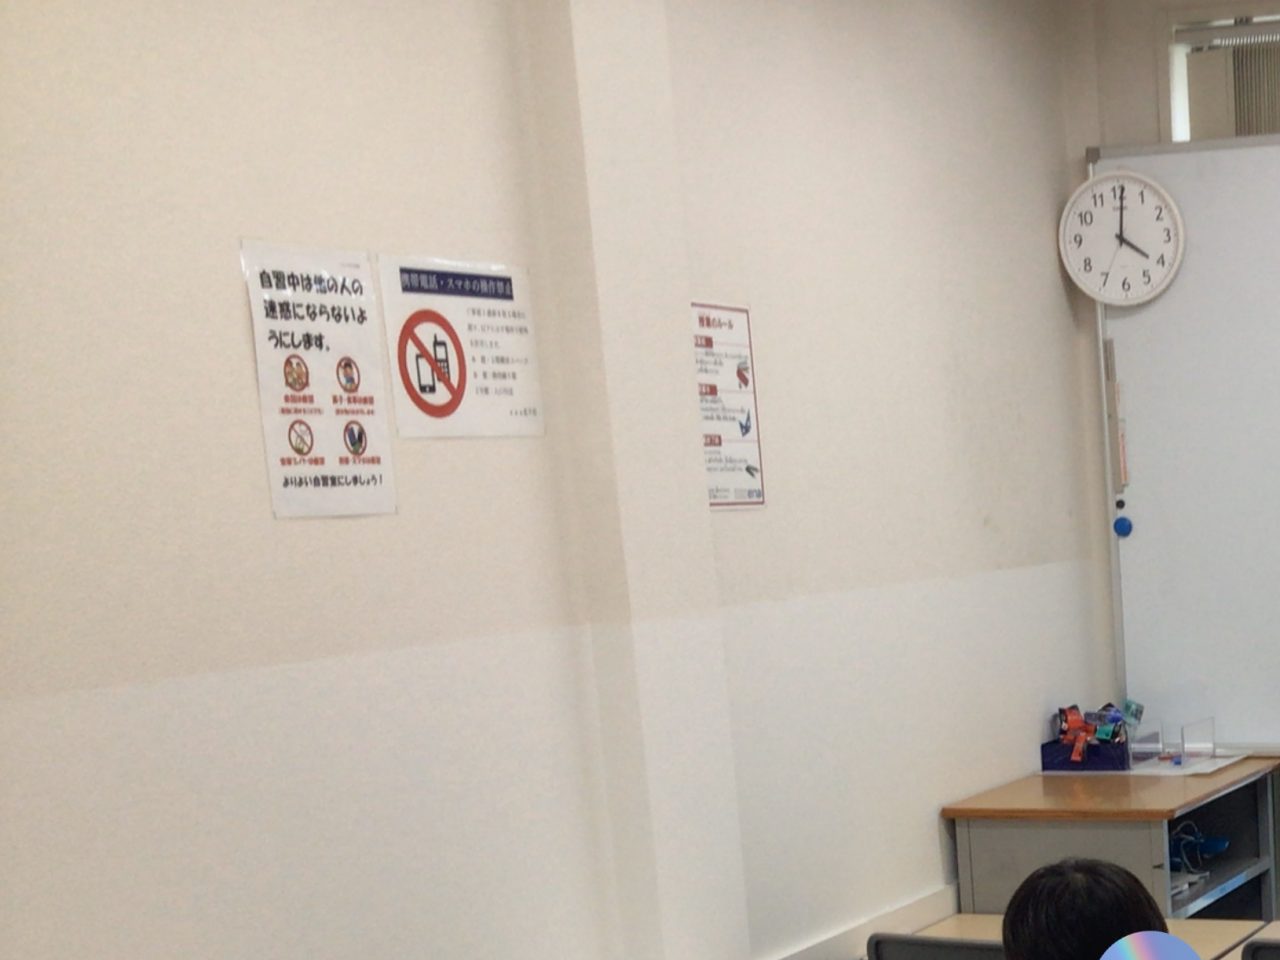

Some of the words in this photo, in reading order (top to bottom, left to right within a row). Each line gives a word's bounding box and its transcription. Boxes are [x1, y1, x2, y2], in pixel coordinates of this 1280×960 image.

[1092, 193, 1104, 207] 11
[1138, 190, 1145, 204] 1
[1078, 211, 1093, 226] 10
[1154, 206, 1163, 221] 2
[1073, 234, 1083, 248] 9
[1163, 228, 1171, 243] 3
[1083, 257, 1092, 272] 8
[1156, 253, 1165, 267] 4
[260, 270, 363, 295] 自習中は他の人の
[1101, 272, 1110, 287] 7
[1121, 277, 1131, 292] 6
[1142, 270, 1151, 284] 5
[263, 299, 367, 325] 迷惑にならないよ
[268, 329, 330, 351] うにします。
